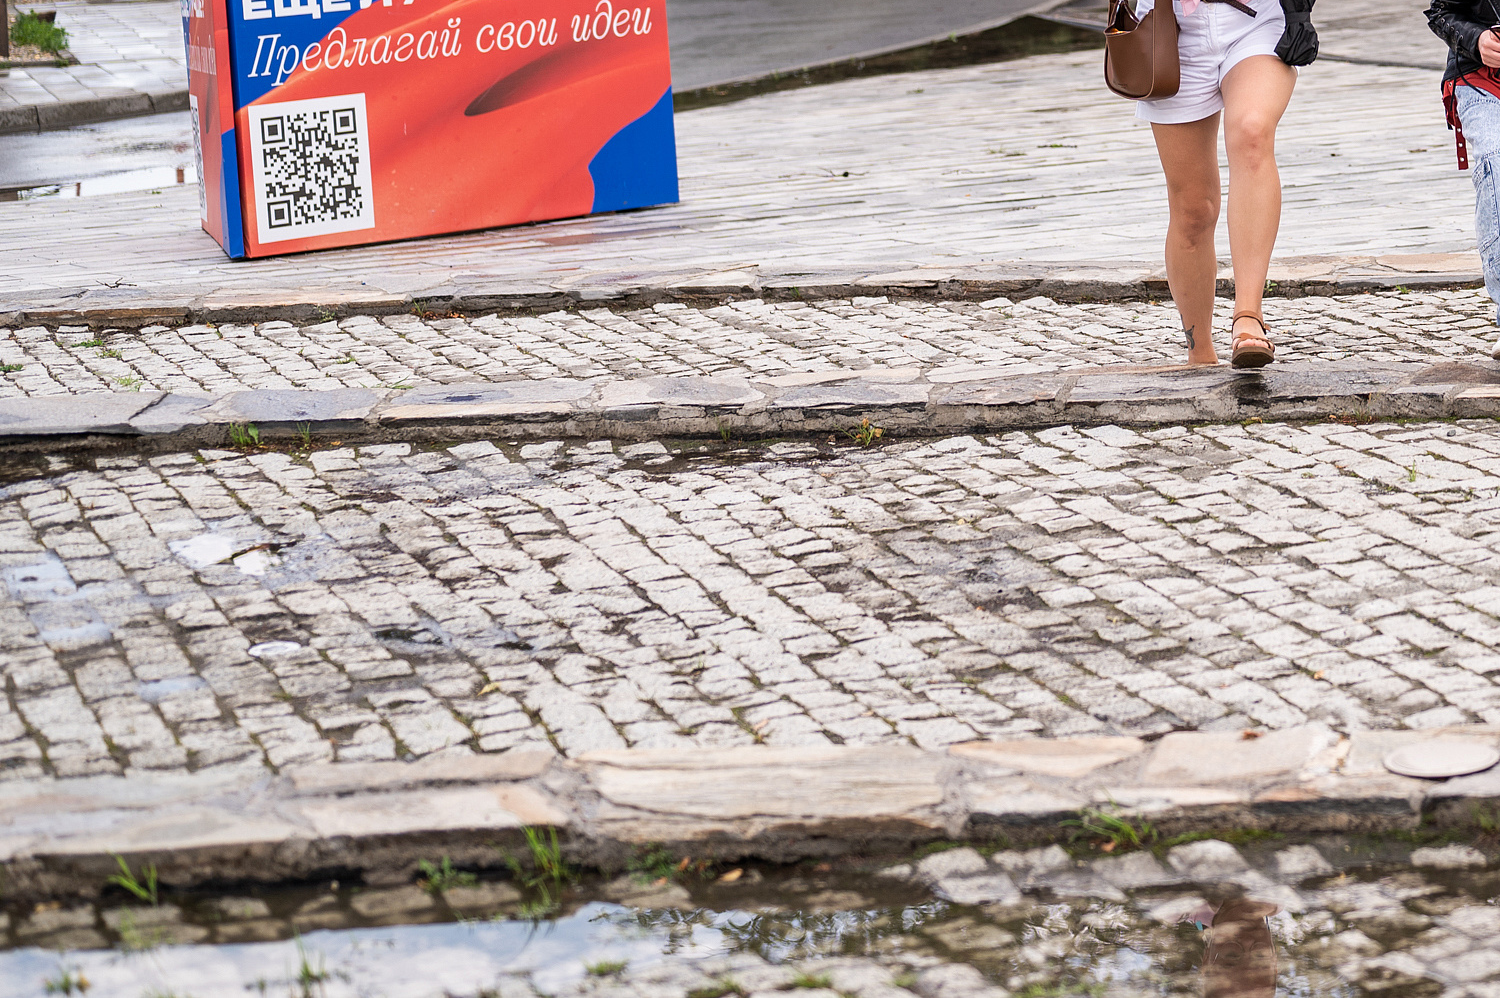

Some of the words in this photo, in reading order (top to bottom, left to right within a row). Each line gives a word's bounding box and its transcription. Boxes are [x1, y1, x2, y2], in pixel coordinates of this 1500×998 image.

[247, 17, 462, 87] Предлагай
[476, 13, 557, 53] свои
[571, 0, 652, 42] идеи
